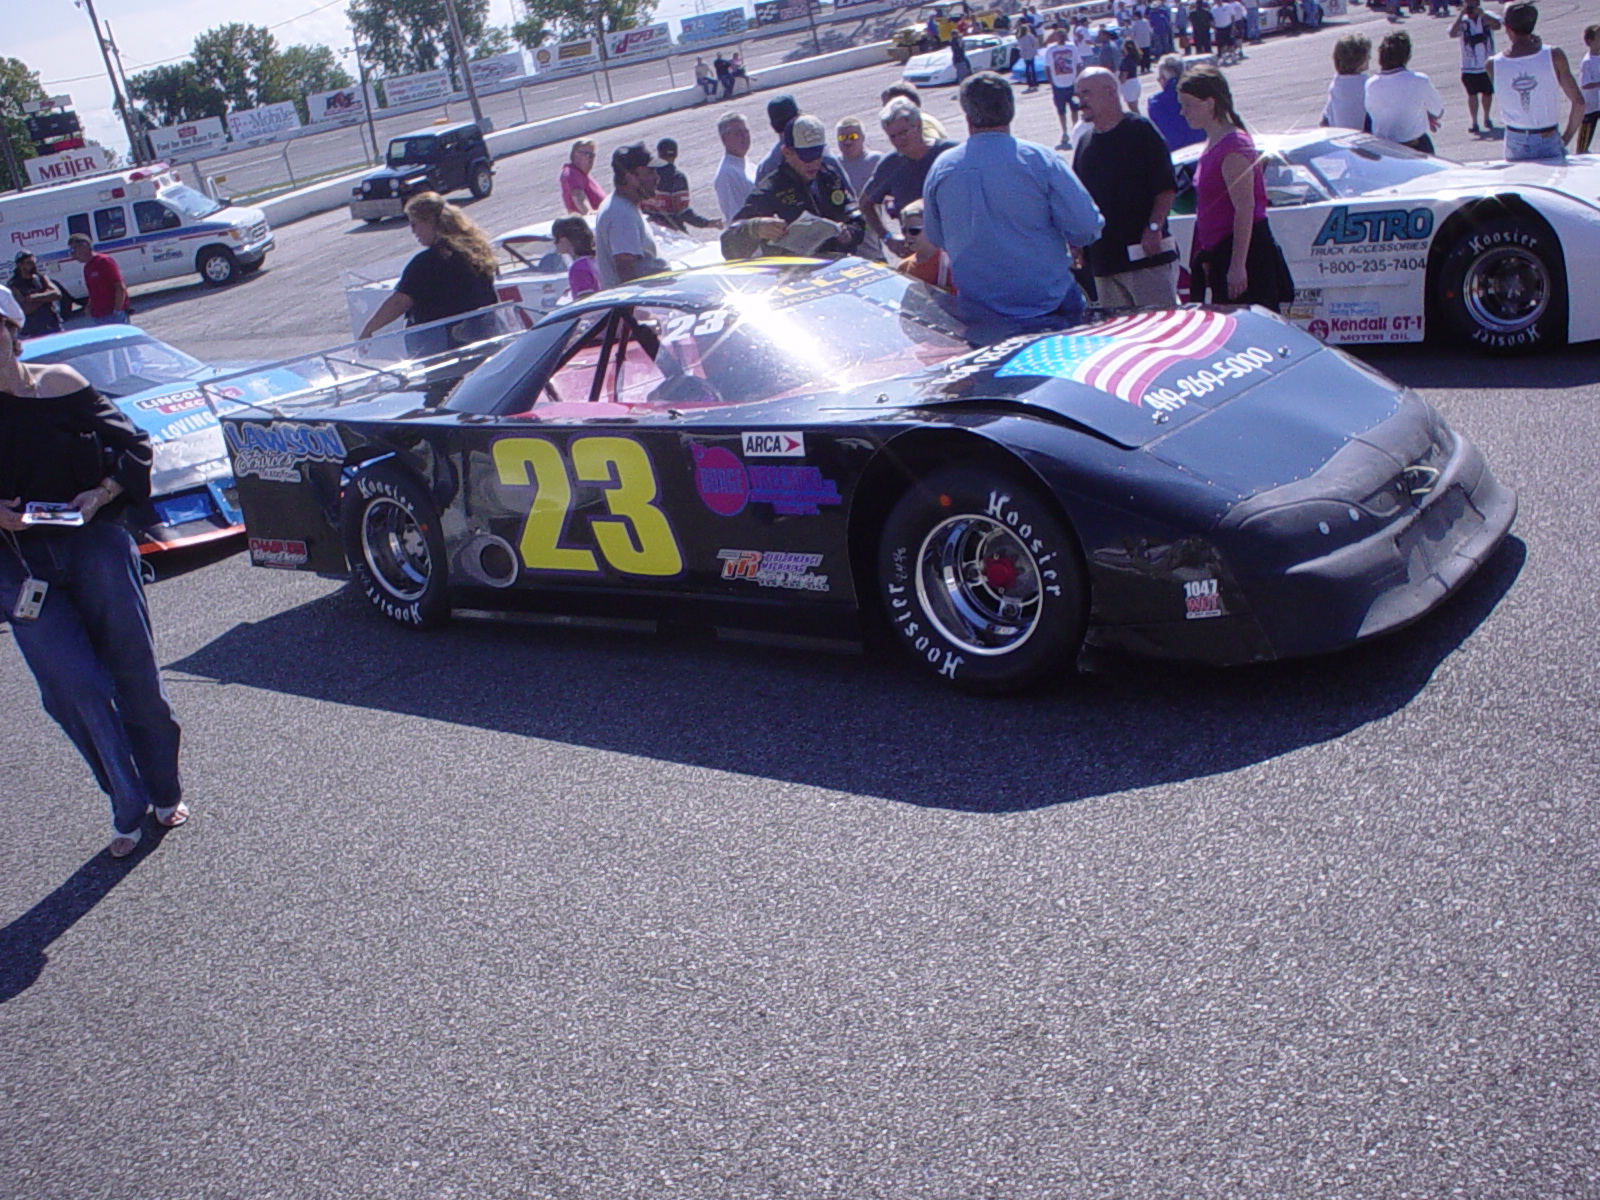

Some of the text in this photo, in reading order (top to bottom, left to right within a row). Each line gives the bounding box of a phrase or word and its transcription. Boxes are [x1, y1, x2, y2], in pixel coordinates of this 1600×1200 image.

[11, 223, 60, 247] Rumpf
[1312, 206, 1434, 247] ASTRO
[1468, 228, 1539, 256] Hoosier
[1311, 241, 1429, 256] TRUCK ACCESSORIES
[1318, 257, 1426, 275] 1-800-235-7404
[661, 310, 729, 344] 23
[1331, 315, 1422, 331] Kendall GT-1
[1340, 332, 1410, 341] MOTOR OIL
[1143, 347, 1273, 411] 419-269-5000
[225, 422, 347, 459] LAWSON
[746, 435, 782, 452] ARCA
[357, 477, 414, 512] Hoosier
[492, 436, 683, 576] 23
[985, 489, 1062, 597] Hoosier
[889, 583, 965, 679] Hoosier
